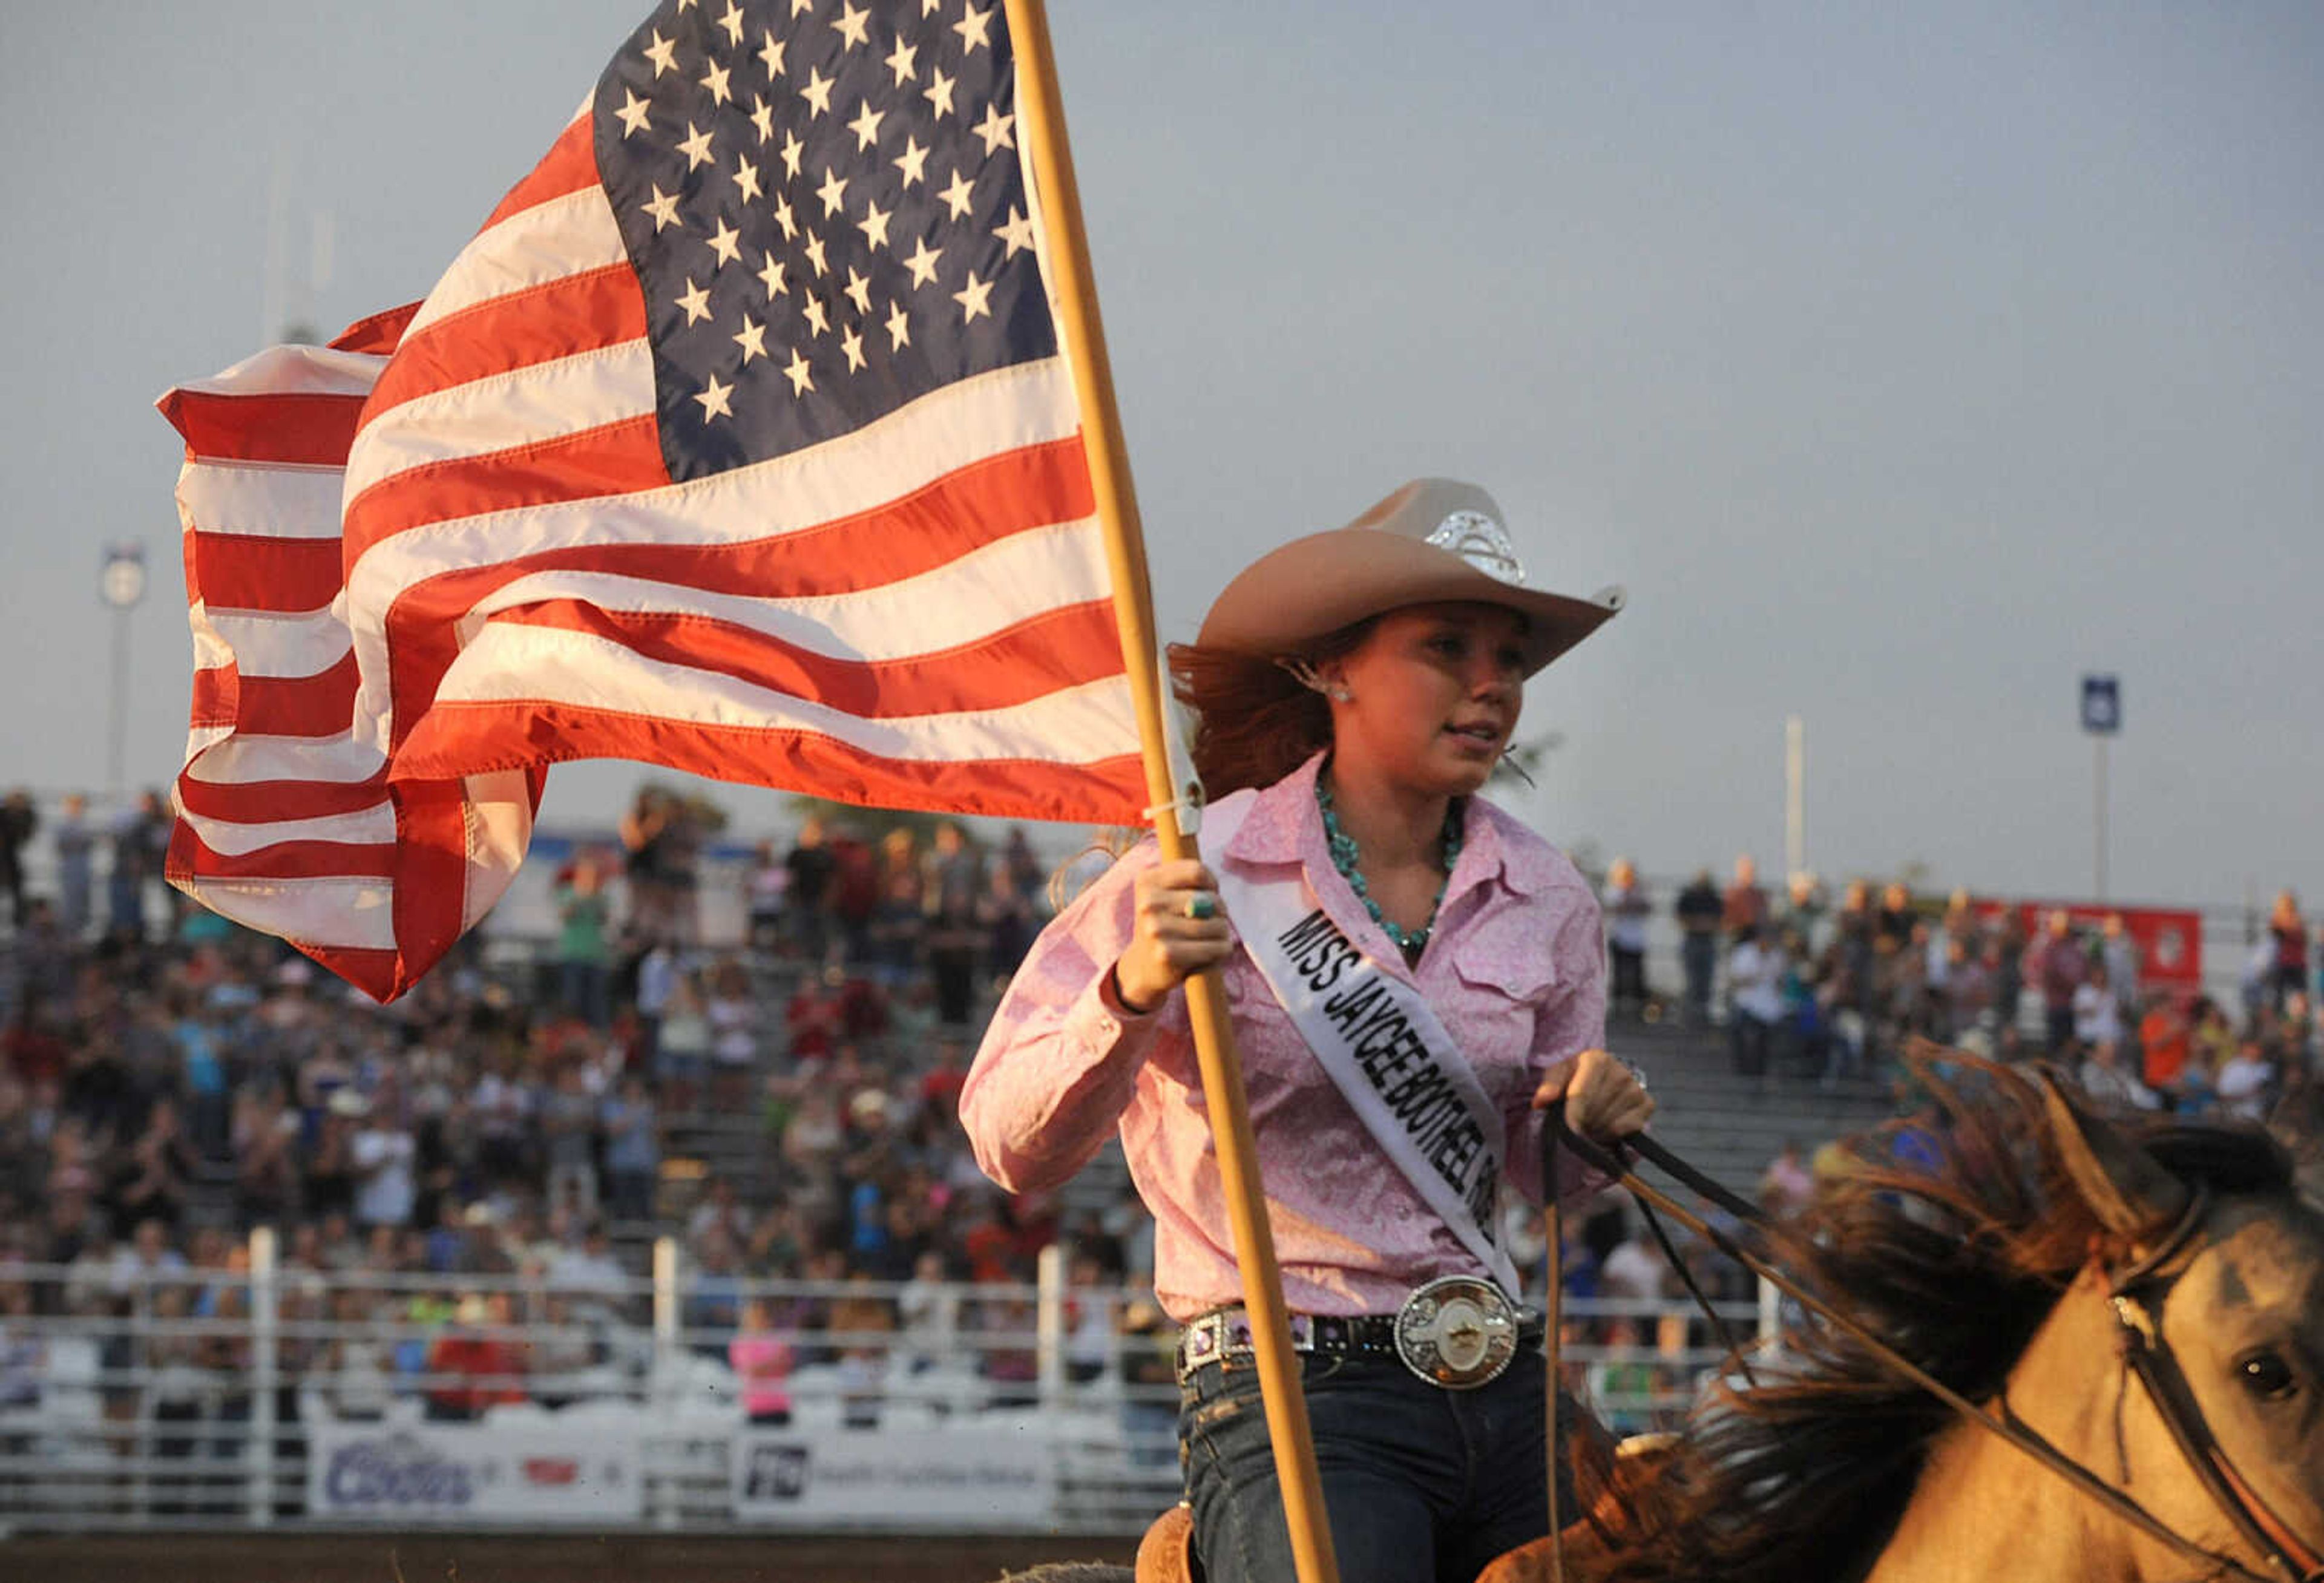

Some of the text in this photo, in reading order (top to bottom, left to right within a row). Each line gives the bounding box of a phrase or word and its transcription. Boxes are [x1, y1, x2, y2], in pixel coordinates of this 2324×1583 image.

[1278, 909, 1487, 1196] MISS JAYCEE BOOTHEEL
